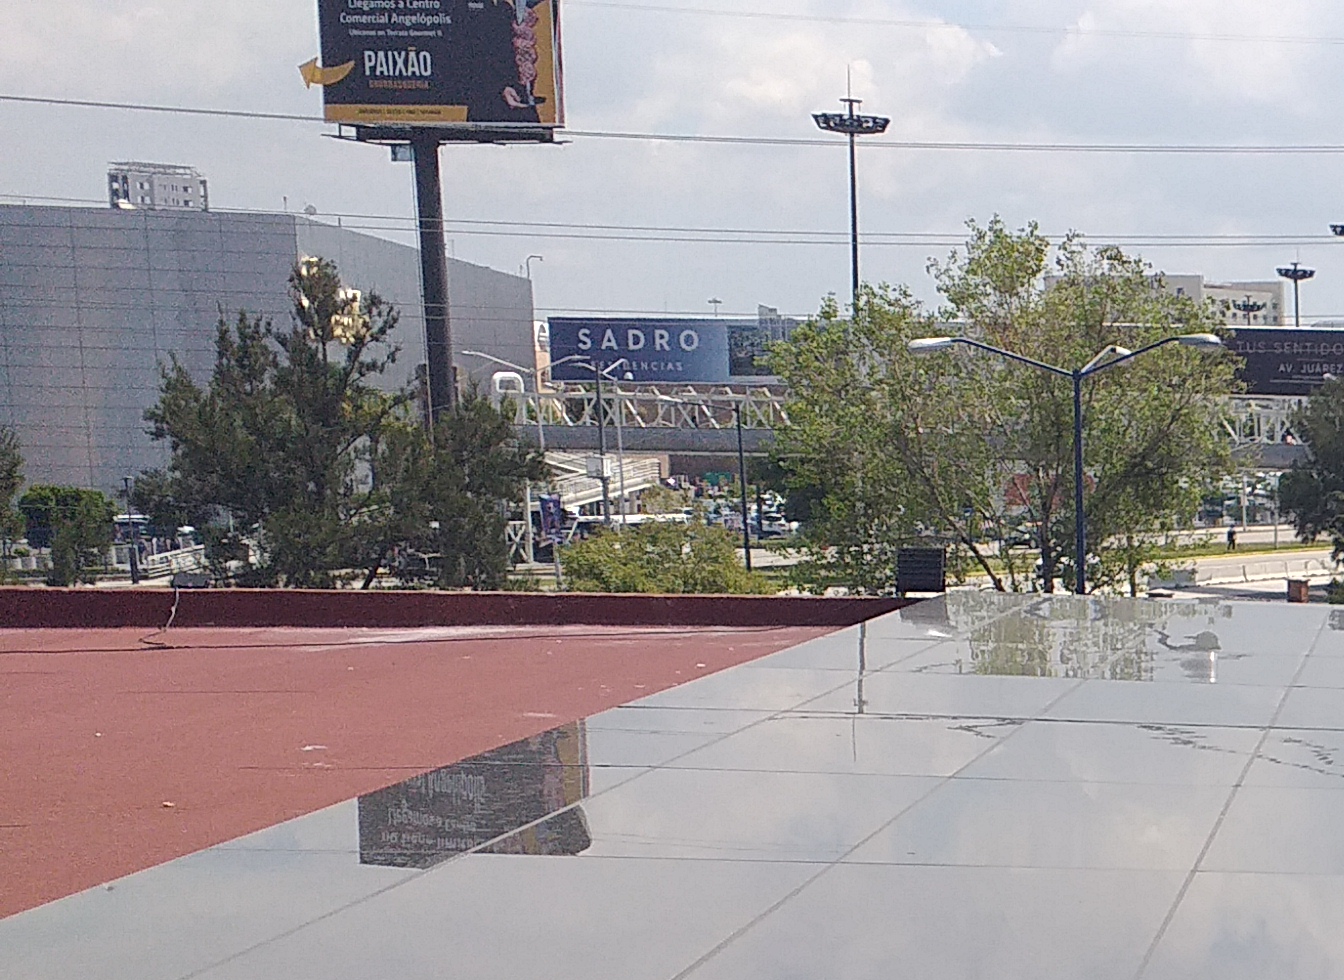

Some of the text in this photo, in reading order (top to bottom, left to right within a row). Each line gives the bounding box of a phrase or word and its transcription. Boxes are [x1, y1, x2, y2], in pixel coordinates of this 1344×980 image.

[340, 12, 452, 26] Comercial Angelópolis
[363, 46, 432, 77] PAIXÃO
[577, 328, 699, 351] SADRO
[1236, 341, 1266, 353] TUS
